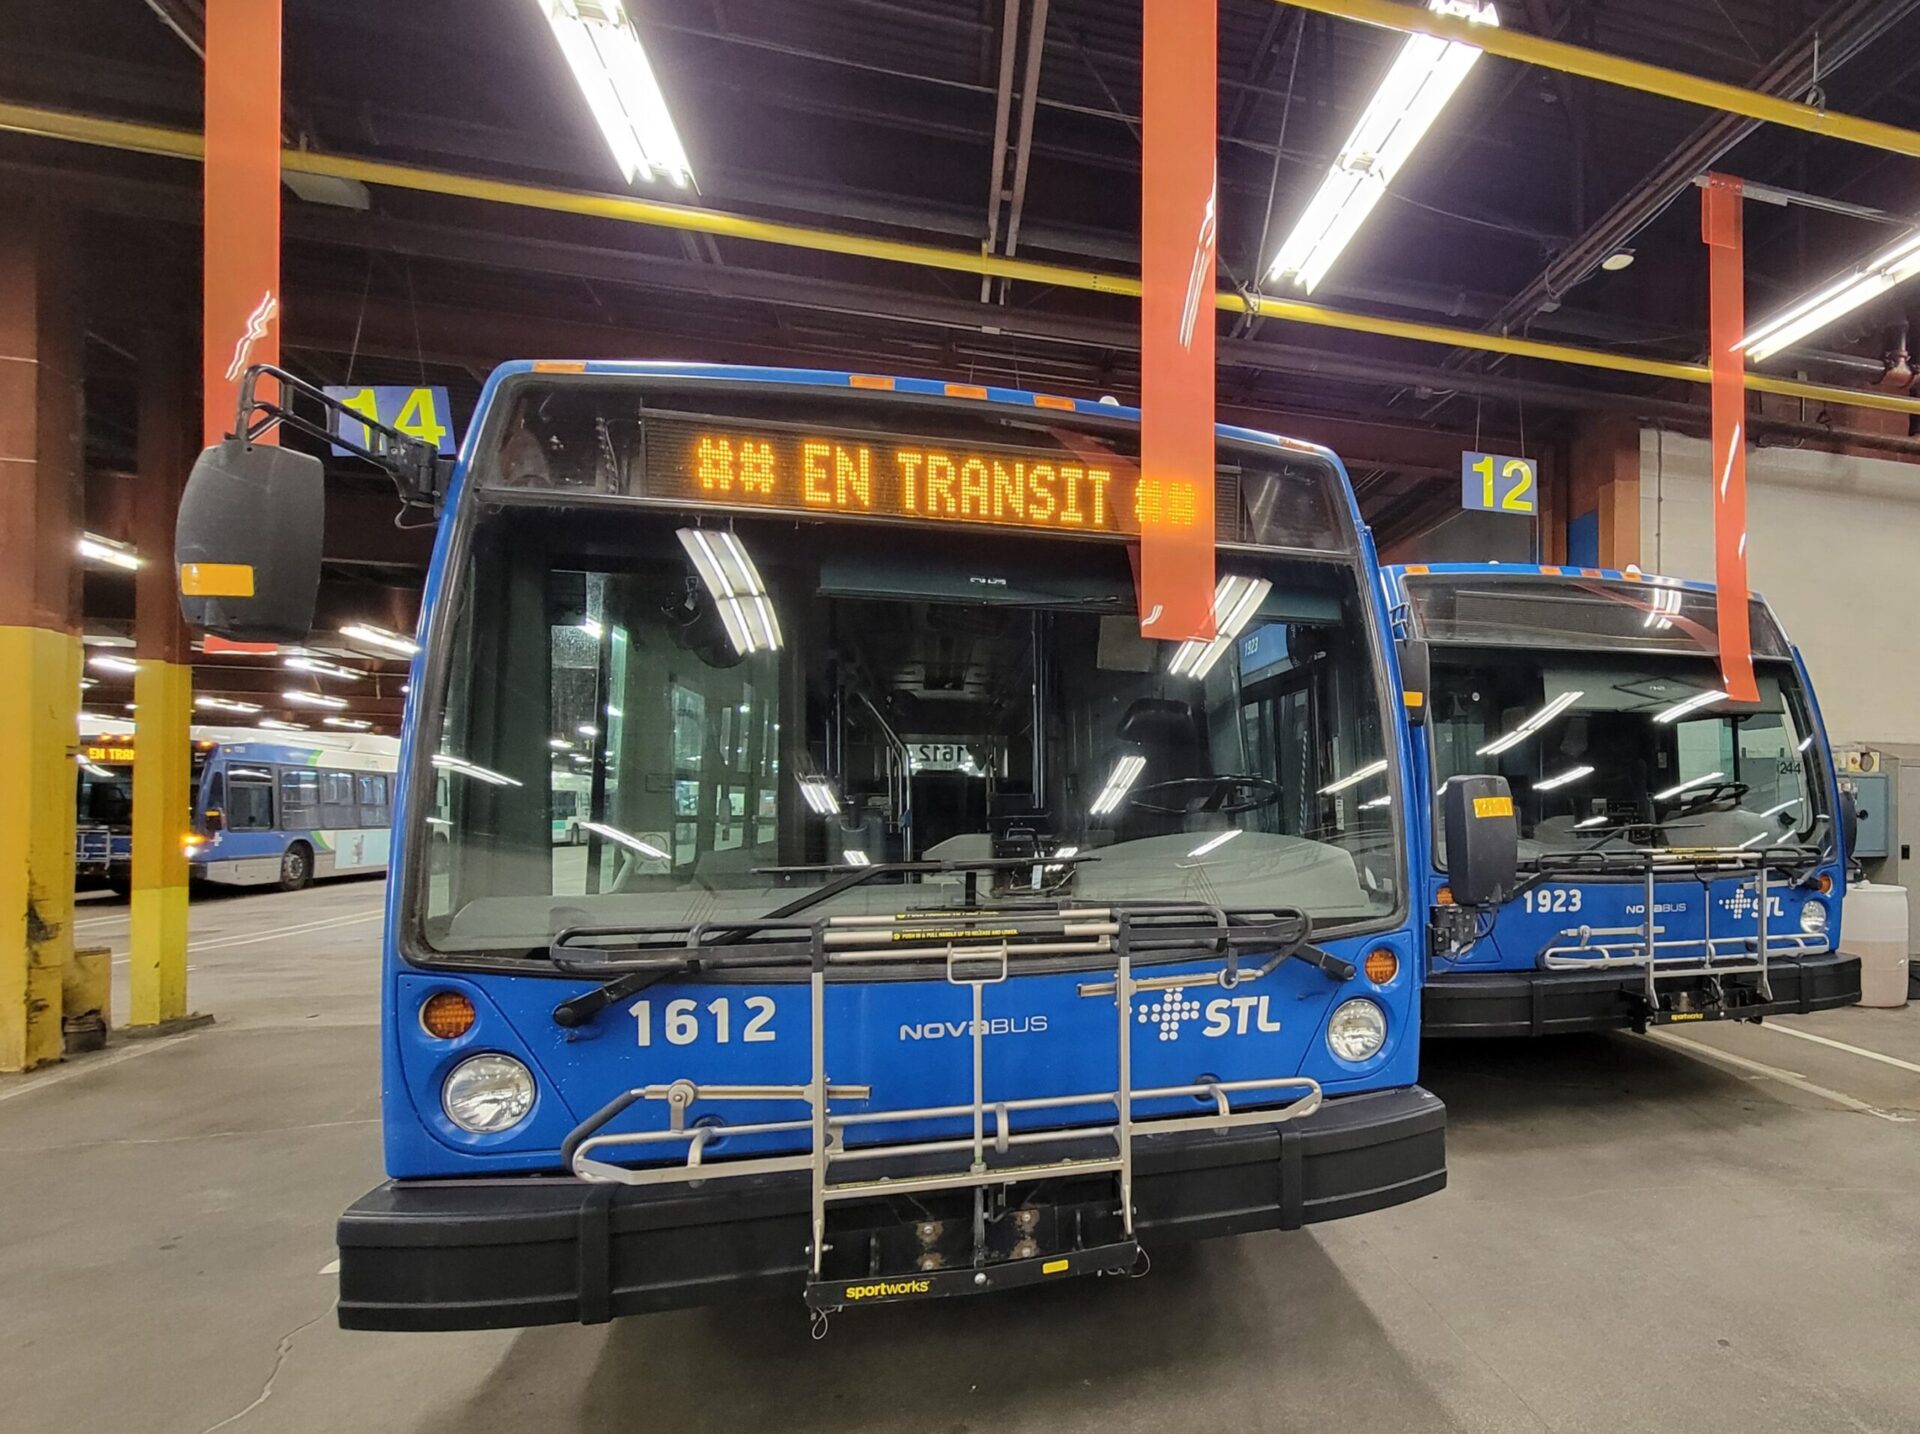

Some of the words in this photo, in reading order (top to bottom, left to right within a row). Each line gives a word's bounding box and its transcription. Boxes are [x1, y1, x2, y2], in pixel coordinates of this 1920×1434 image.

[342, 388, 446, 452] 14
[804, 443, 869, 506] EN
[897, 452, 1110, 524] TRANSIT
[1472, 456, 1532, 511] 12
[1524, 889, 1582, 914] 1923
[926, 931, 937, 939] PULL
[628, 996, 776, 1047] 1612
[1202, 995, 1281, 1037] STL
[845, 1280, 930, 1299] sportworks
